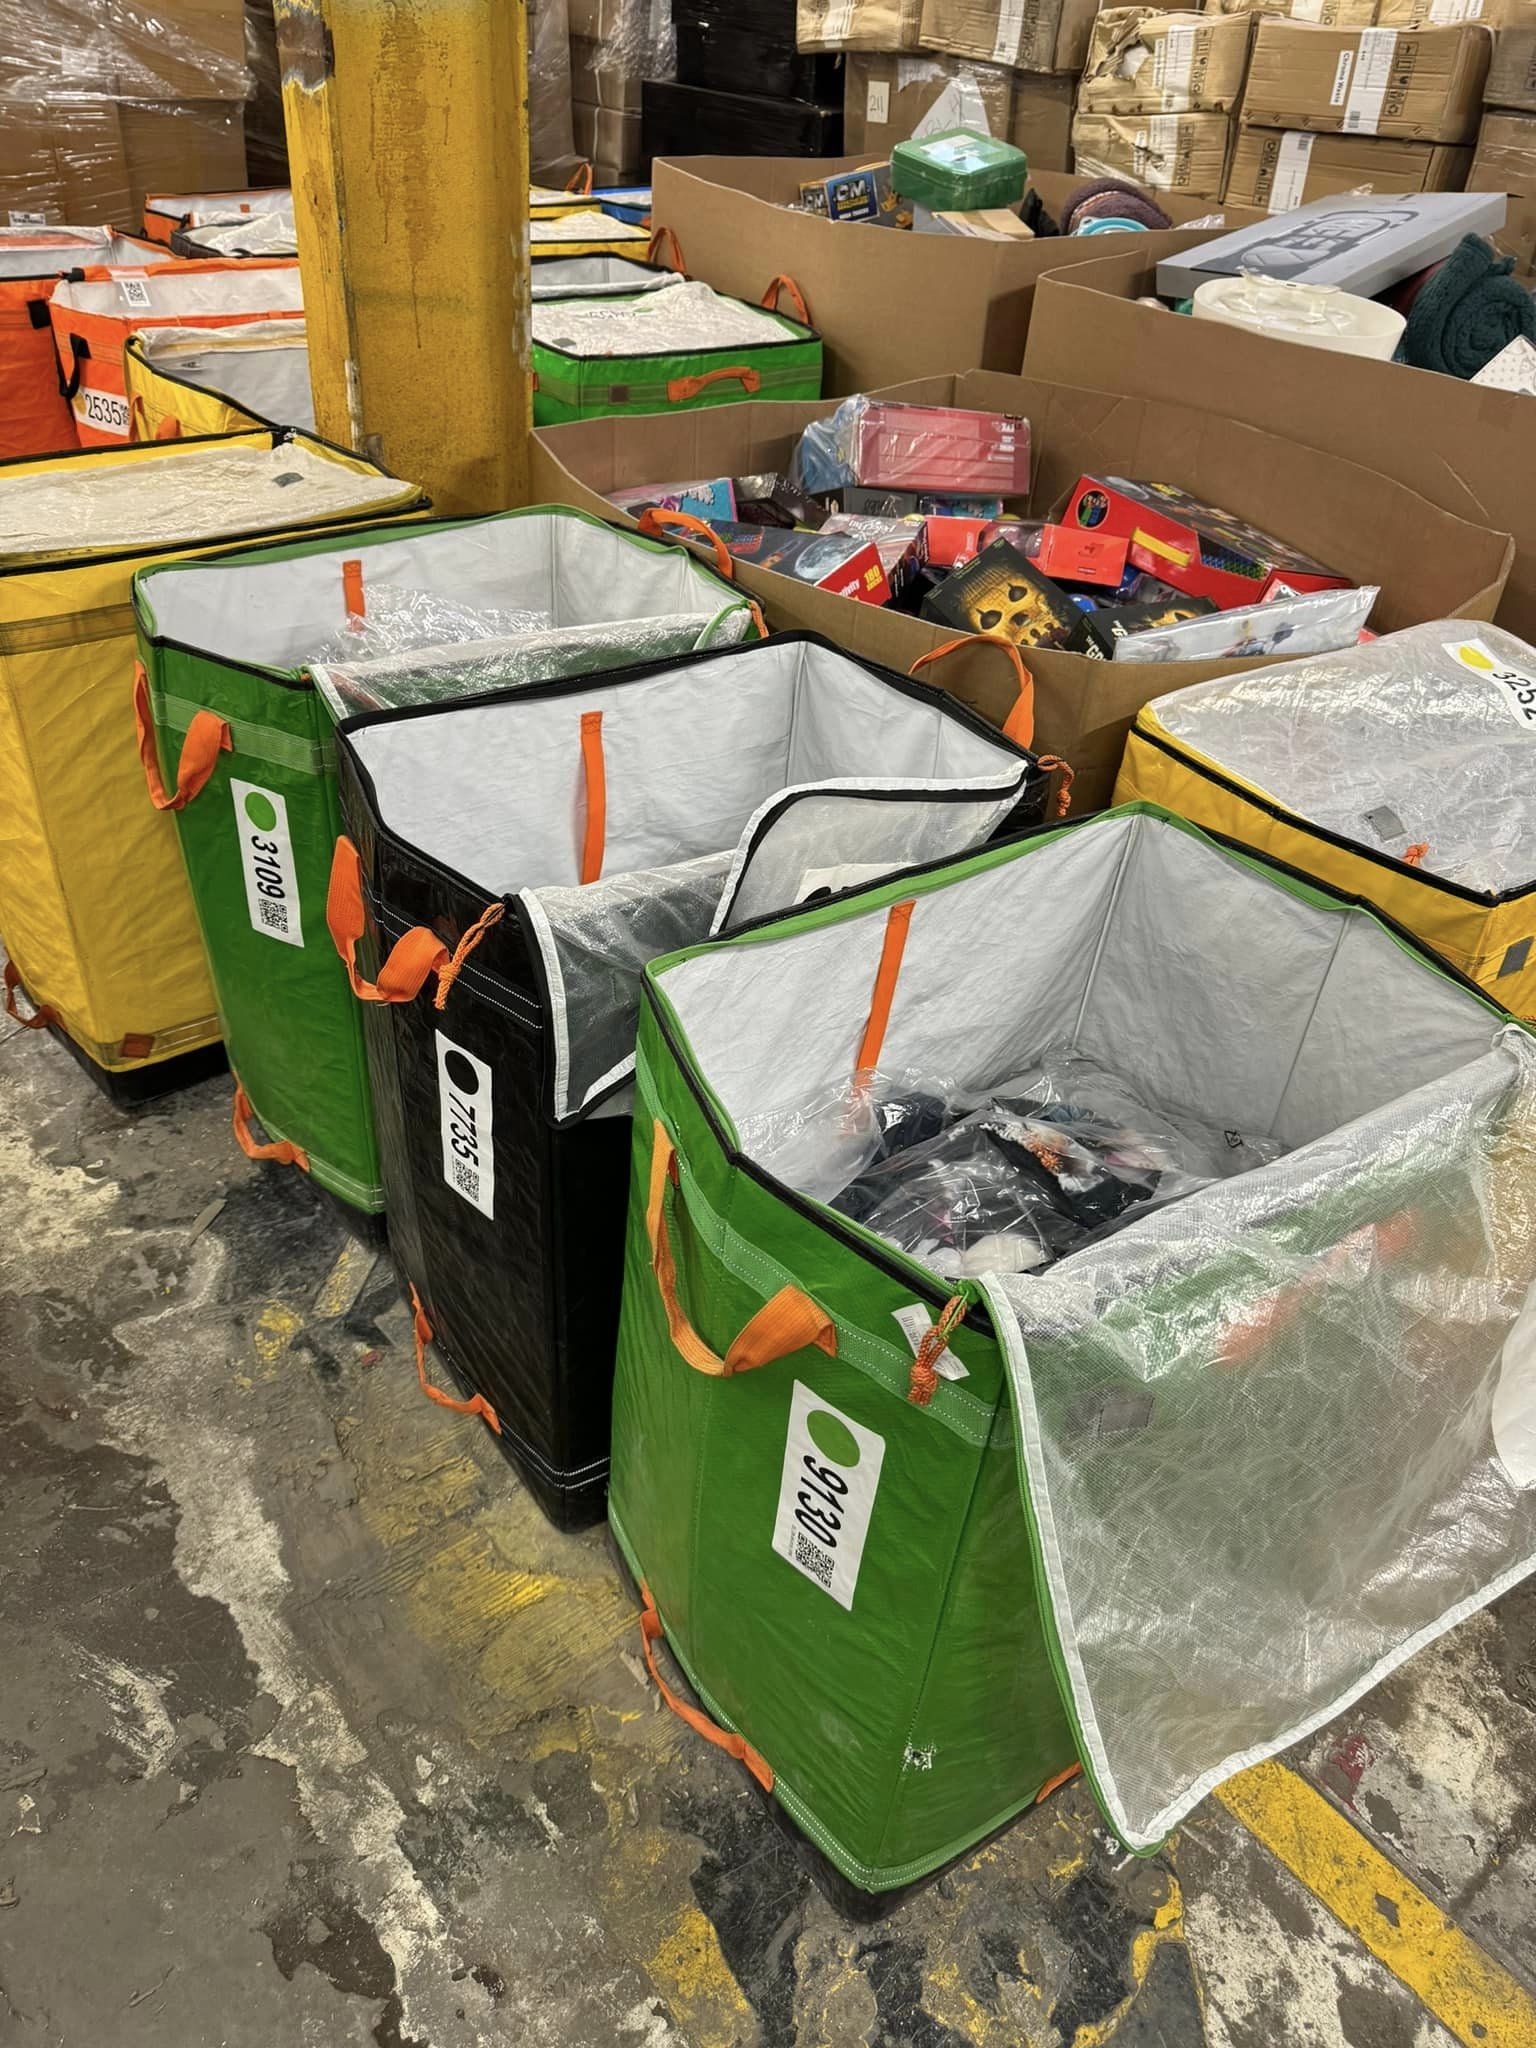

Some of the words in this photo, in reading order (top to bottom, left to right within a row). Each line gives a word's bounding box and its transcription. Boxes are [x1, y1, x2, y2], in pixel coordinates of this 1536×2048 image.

[85, 394, 122, 426] 2535
[251, 835, 286, 899] 3109
[449, 1092, 479, 1167] 7735
[795, 1453, 848, 1548] 9130
